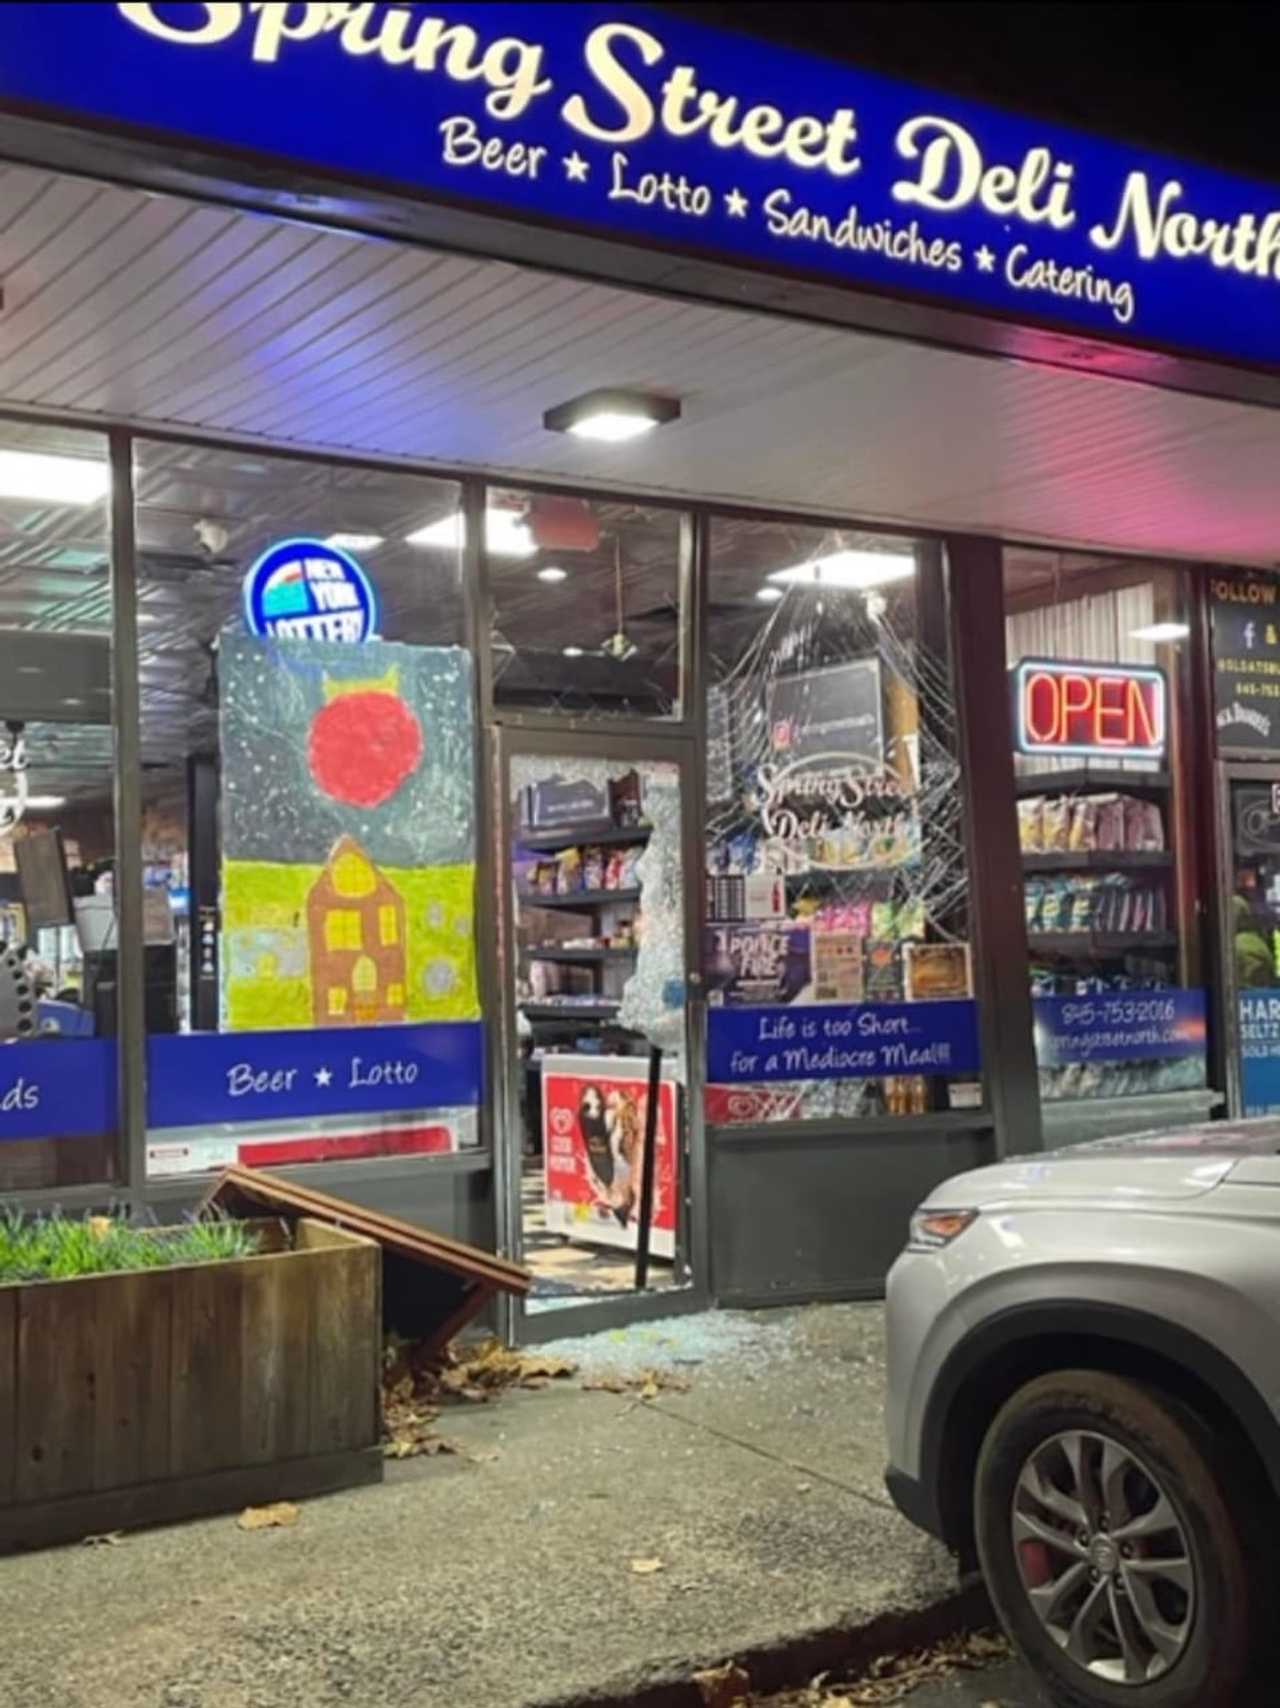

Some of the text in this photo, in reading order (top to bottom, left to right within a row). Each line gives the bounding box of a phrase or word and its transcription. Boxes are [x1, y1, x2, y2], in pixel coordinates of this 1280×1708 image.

[561, 23, 861, 176] Street
[891, 115, 1076, 229] Deli
[1089, 171, 1280, 280] North
[439, 117, 1136, 324] Beer Lotto Sandwiches Catering
[1026, 672, 1156, 746] OPEN
[759, 1016, 795, 1040] Life
[802, 1020, 817, 1037] is
[823, 1017, 852, 1036] too
[227, 1057, 419, 1097] Beer Lotto
[730, 1051, 758, 1074] for
[764, 1054, 779, 1071] a
[783, 1046, 876, 1071] Mediocre
